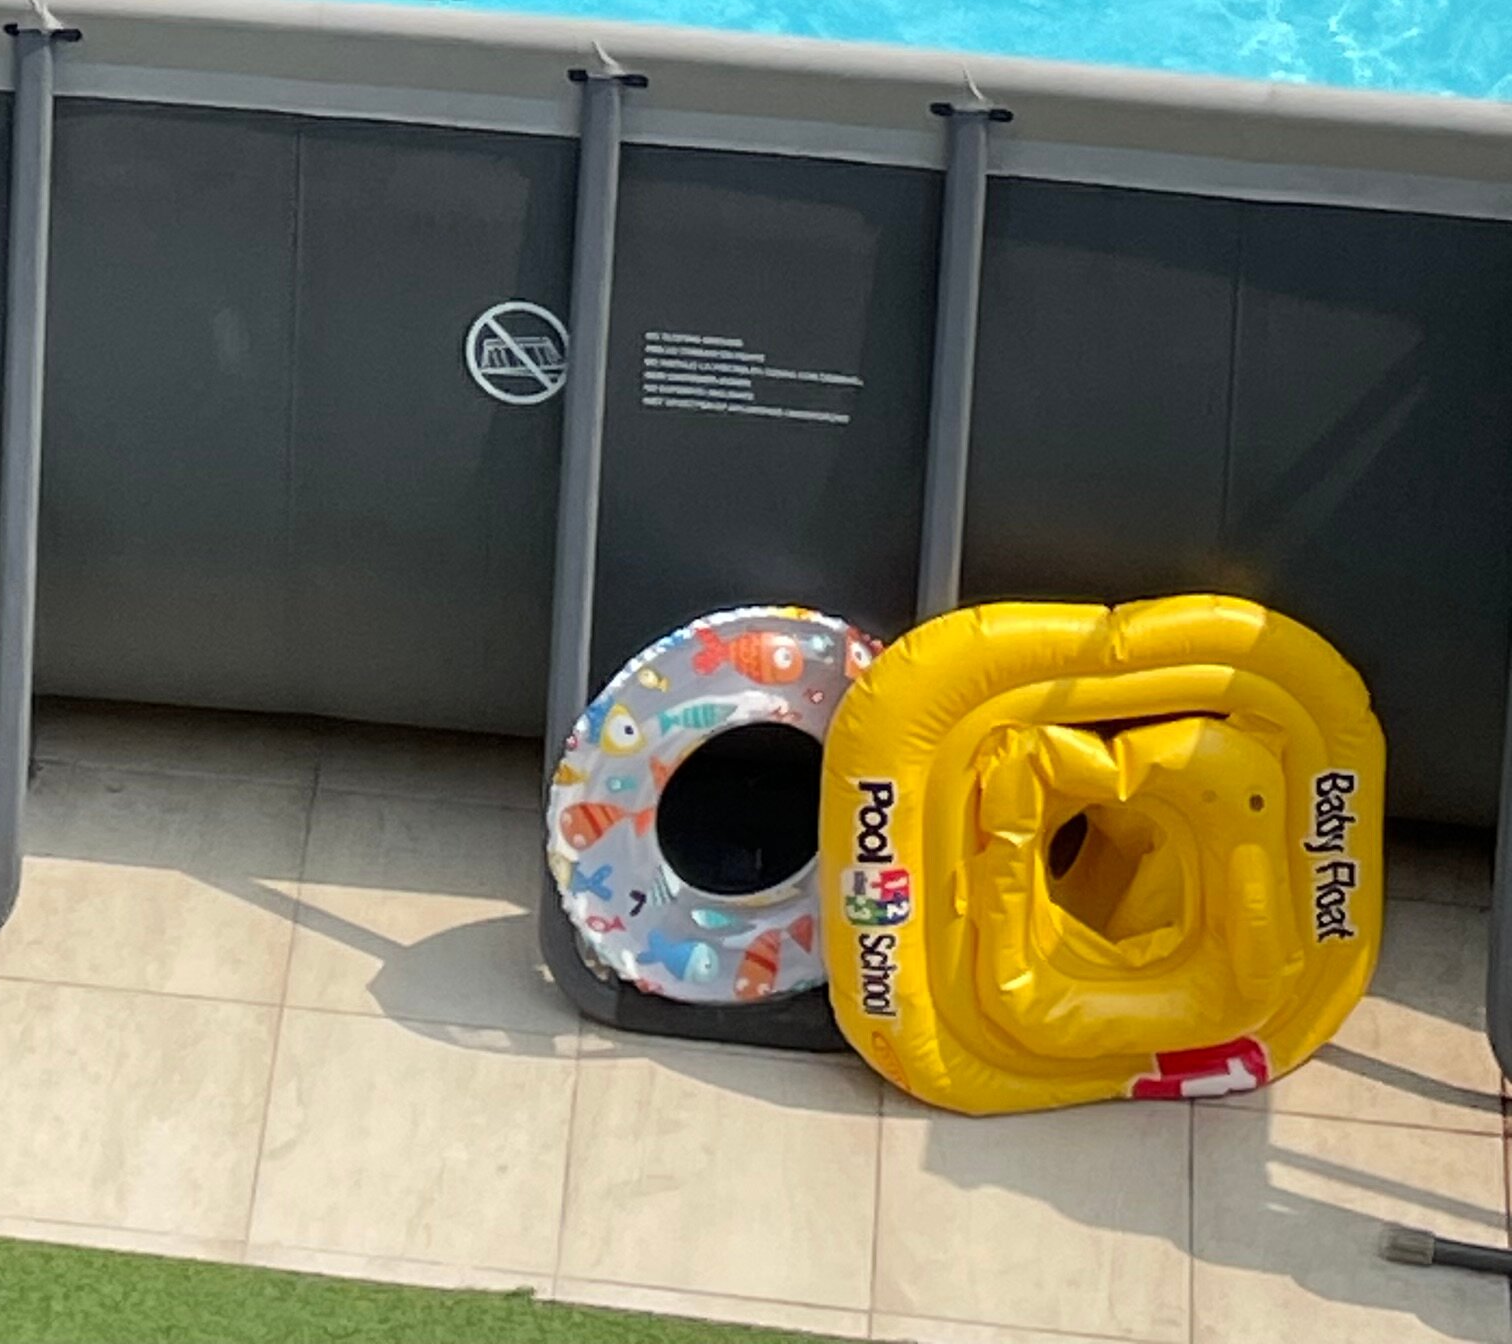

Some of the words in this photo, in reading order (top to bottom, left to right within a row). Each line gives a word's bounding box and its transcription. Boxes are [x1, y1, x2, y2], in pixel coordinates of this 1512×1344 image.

[857, 780, 895, 863] Pool
[1303, 772, 1357, 853] Baby
[1315, 861, 1356, 944] Float
[858, 933, 897, 1017] School
